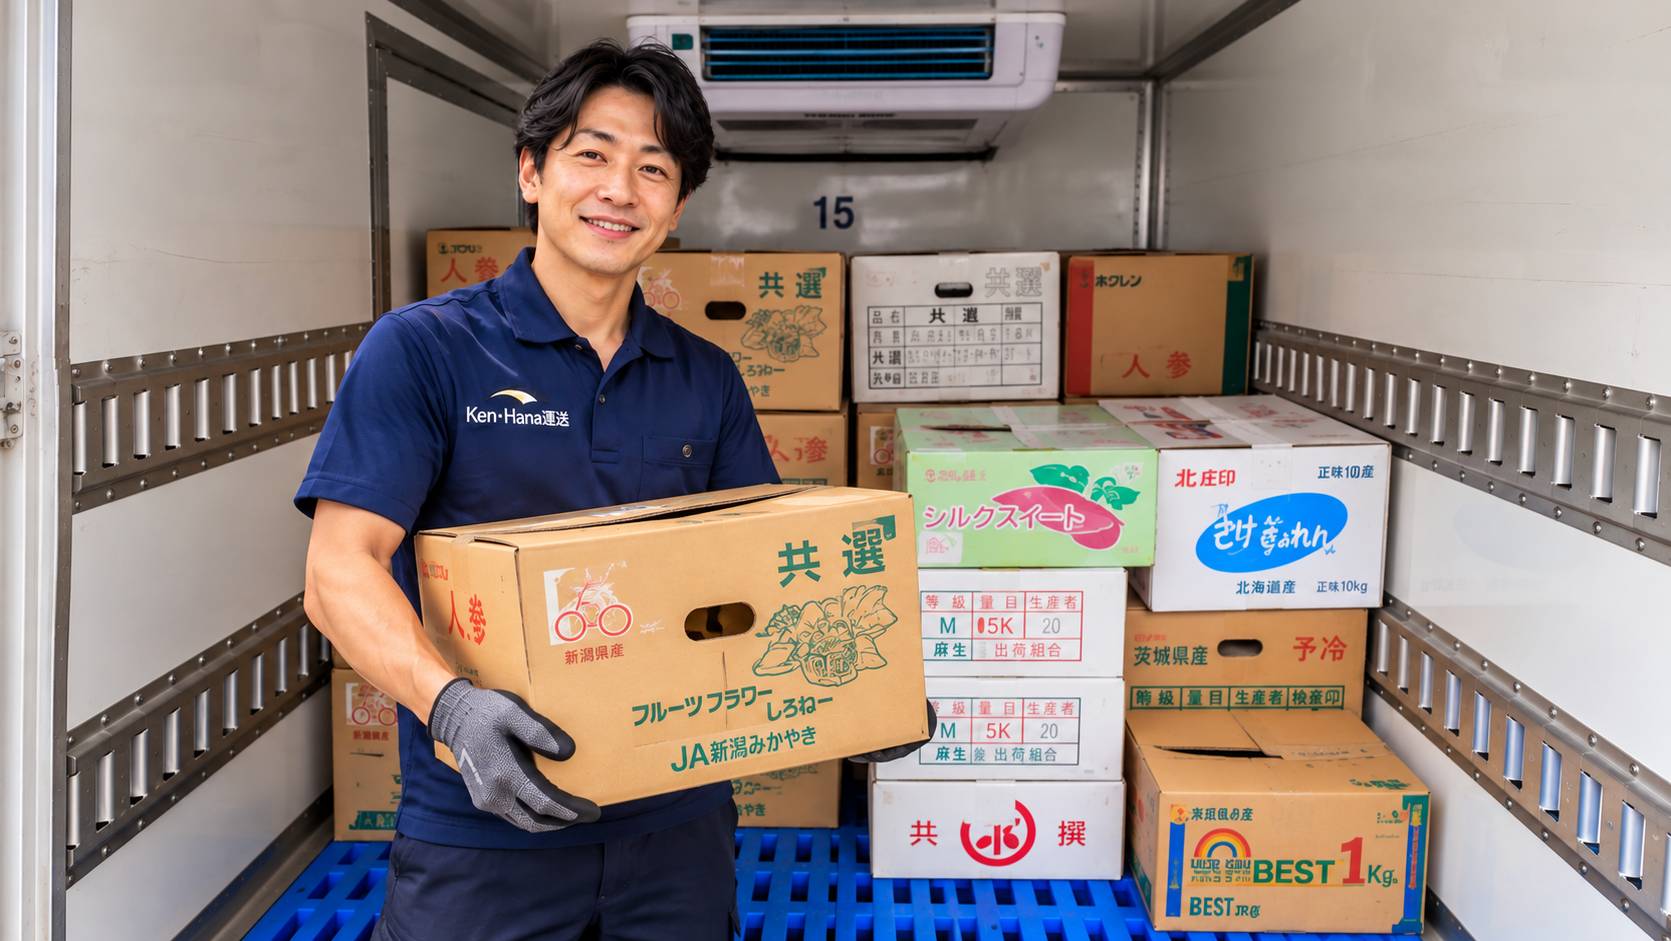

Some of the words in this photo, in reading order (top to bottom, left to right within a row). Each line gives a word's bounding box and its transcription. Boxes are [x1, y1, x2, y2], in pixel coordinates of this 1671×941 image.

[813, 196, 855, 230] 15
[923, 504, 1086, 531] シルクスイート
[777, 526, 887, 588] 共選
[1236, 580, 1296, 594] 北海道産
[926, 595, 965, 609] 等級
[980, 595, 1018, 609] 量目
[1029, 595, 1077, 609] 生産者
[940, 617, 956, 634] M
[1042, 617, 1061, 634] 20
[564, 643, 625, 666] 新潟県産
[933, 642, 967, 657] 麻生
[994, 643, 1062, 658] 出荷組合
[1134, 645, 1208, 666] 茨城県産
[1293, 635, 1347, 662] 予冷
[1235, 690, 1283, 705] 生産者
[766, 695, 833, 722] しろねー
[979, 701, 1015, 715] 量目
[1027, 701, 1075, 716] 生産者
[940, 722, 956, 739] M
[986, 722, 1011, 739] 5K
[1040, 723, 1059, 739] 20
[936, 746, 967, 761] 麻生
[1253, 859, 1335, 884] BEST
[1189, 896, 1235, 917] BEST
